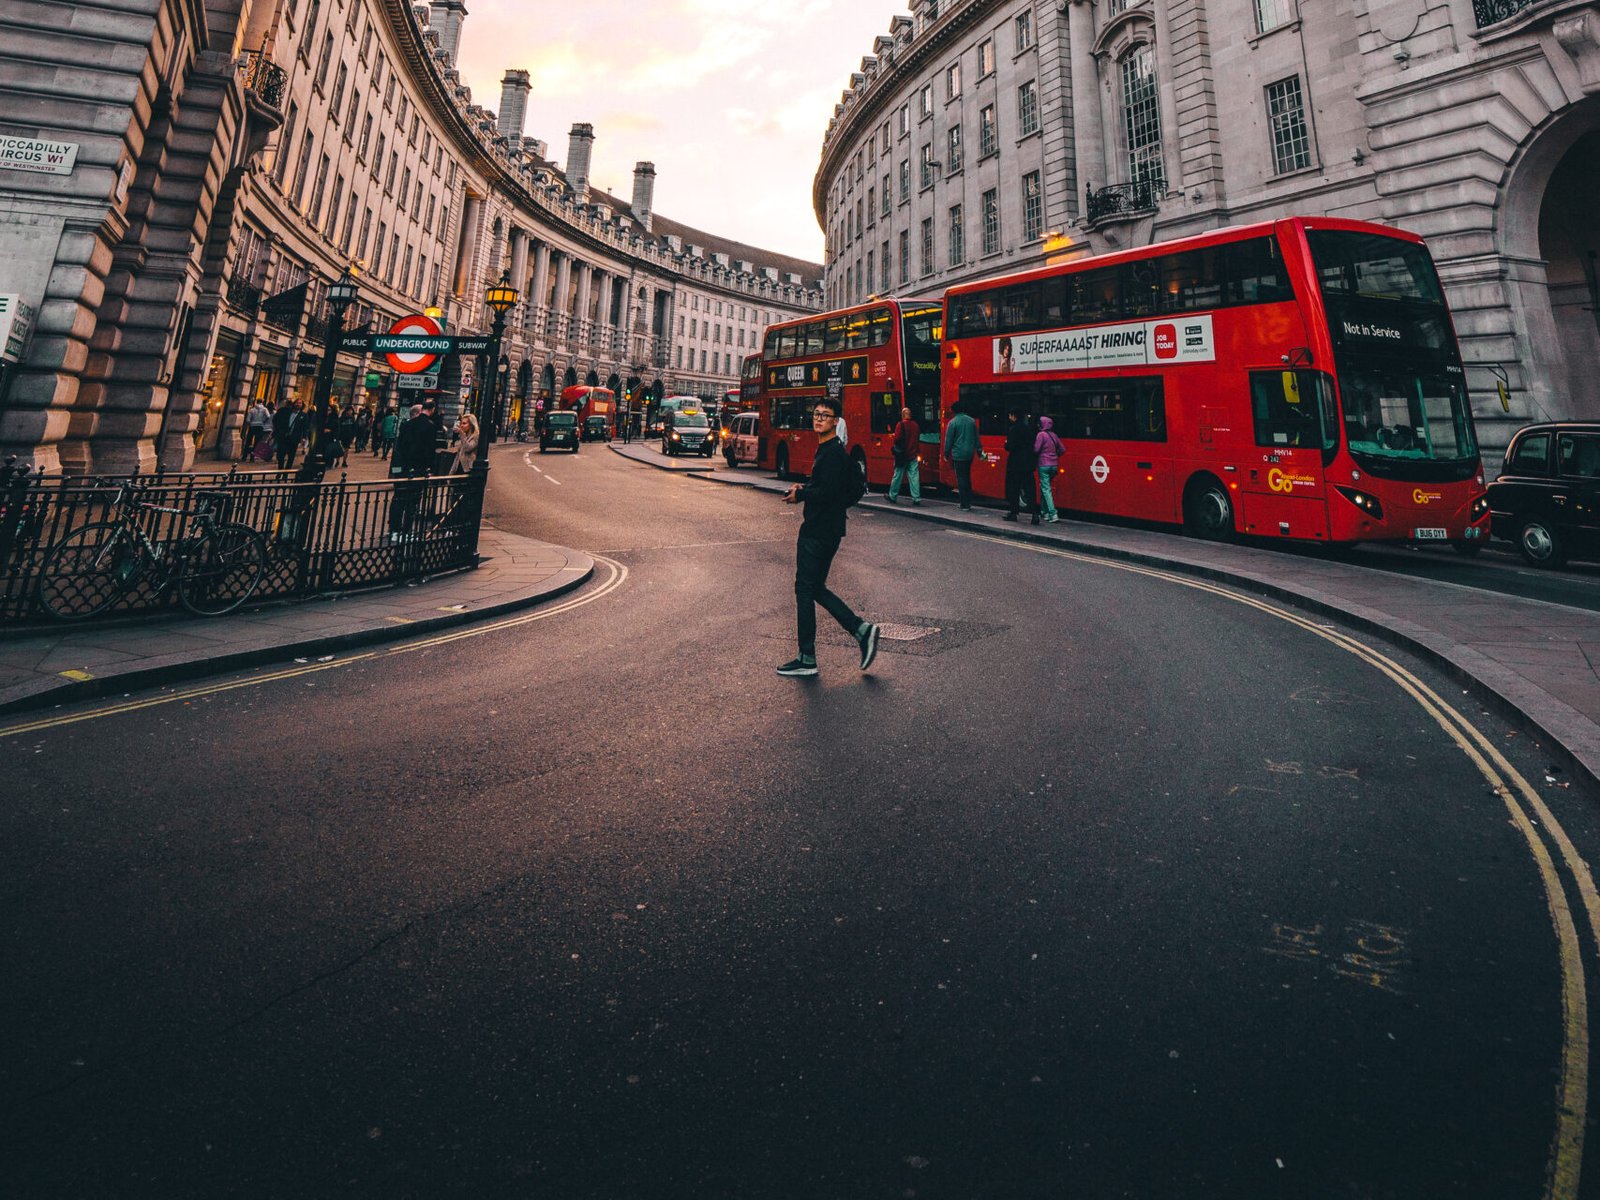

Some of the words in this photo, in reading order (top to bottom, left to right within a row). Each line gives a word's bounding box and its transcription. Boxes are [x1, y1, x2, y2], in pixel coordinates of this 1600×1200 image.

[0, 149, 42, 162] IRCUS
[47, 154, 64, 164] W1
[13, 163, 56, 171] WESTMINSTER
[1343, 321, 1361, 335] Not
[1361, 324, 1370, 336] in
[1370, 324, 1401, 339] Service
[342, 338, 368, 347] PUBLIC
[375, 338, 450, 350] UNDERGROUND
[458, 342, 488, 350] SUBWAY
[1019, 335, 1100, 356] SUPERFAAAAST
[1100, 330, 1147, 349] HIRING!
[1156, 334, 1168, 342] JOB
[1156, 341, 1175, 350] TODAY
[912, 361, 937, 371] Piccadilly
[787, 365, 805, 382] QUEEN
[1413, 488, 1429, 504] Go
